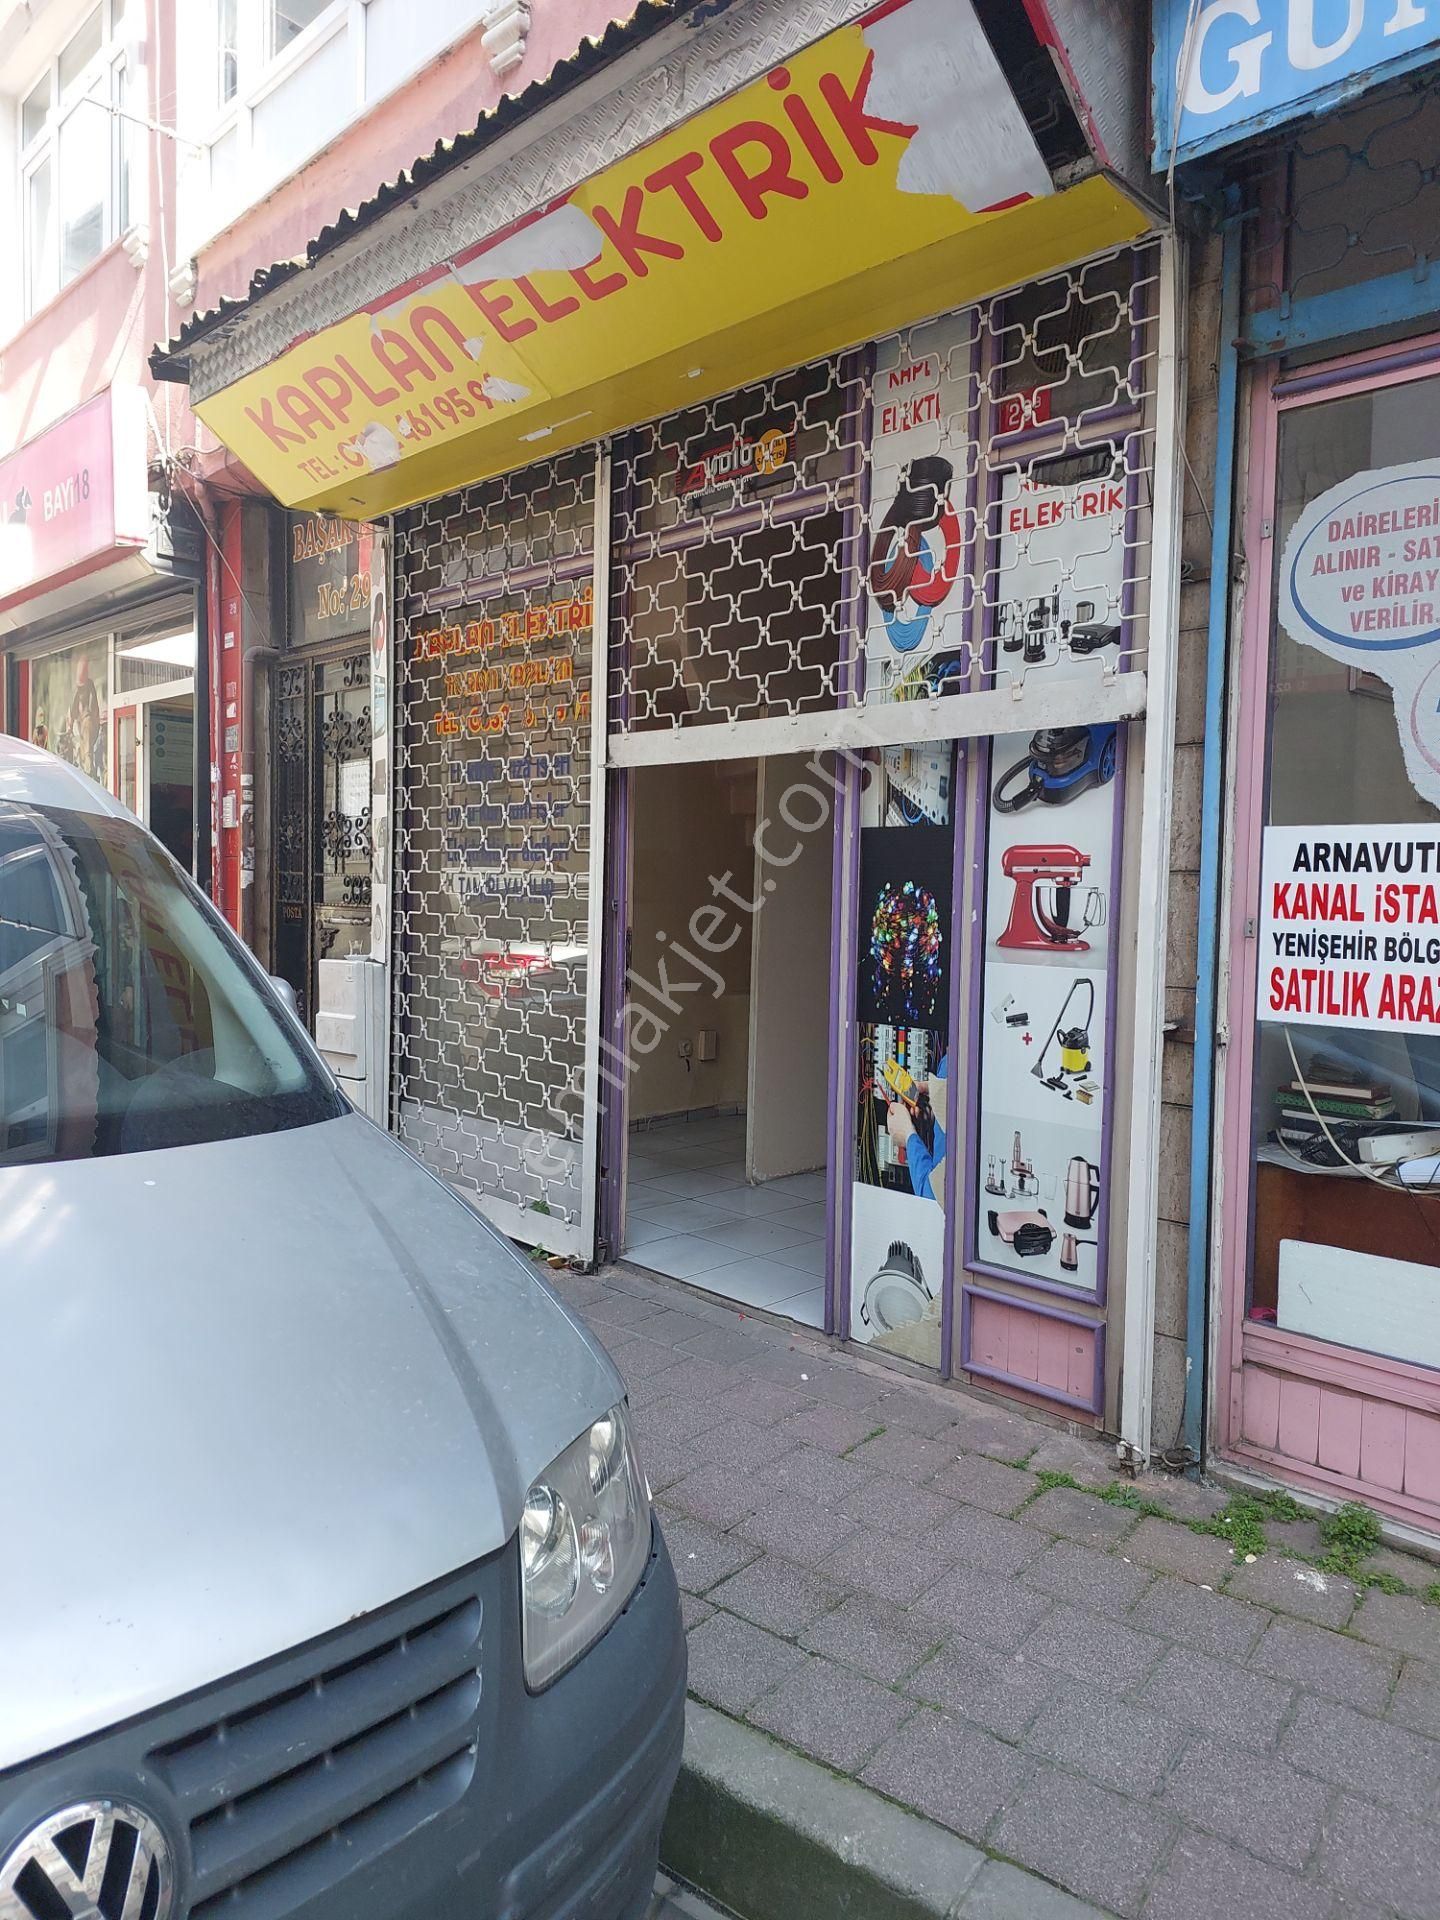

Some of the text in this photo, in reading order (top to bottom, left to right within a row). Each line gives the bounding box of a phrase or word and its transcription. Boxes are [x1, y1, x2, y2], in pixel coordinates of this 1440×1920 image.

[244, 50, 918, 452] KAPLAN ELEKTRİK
[75, 468, 90, 504] 18
[1328, 498, 1440, 542] DAİRELERİ
[1311, 546, 1380, 577] ALINIR
[318, 571, 372, 619] No: 29
[1341, 569, 1440, 602] ve KİRAY
[1293, 841, 1440, 873] ARNAVUT
[1273, 883, 1364, 921] KANAL
[1273, 928, 1440, 964] YENİŞEHİR BÖLG
[1270, 966, 1370, 1018] SATILIK
